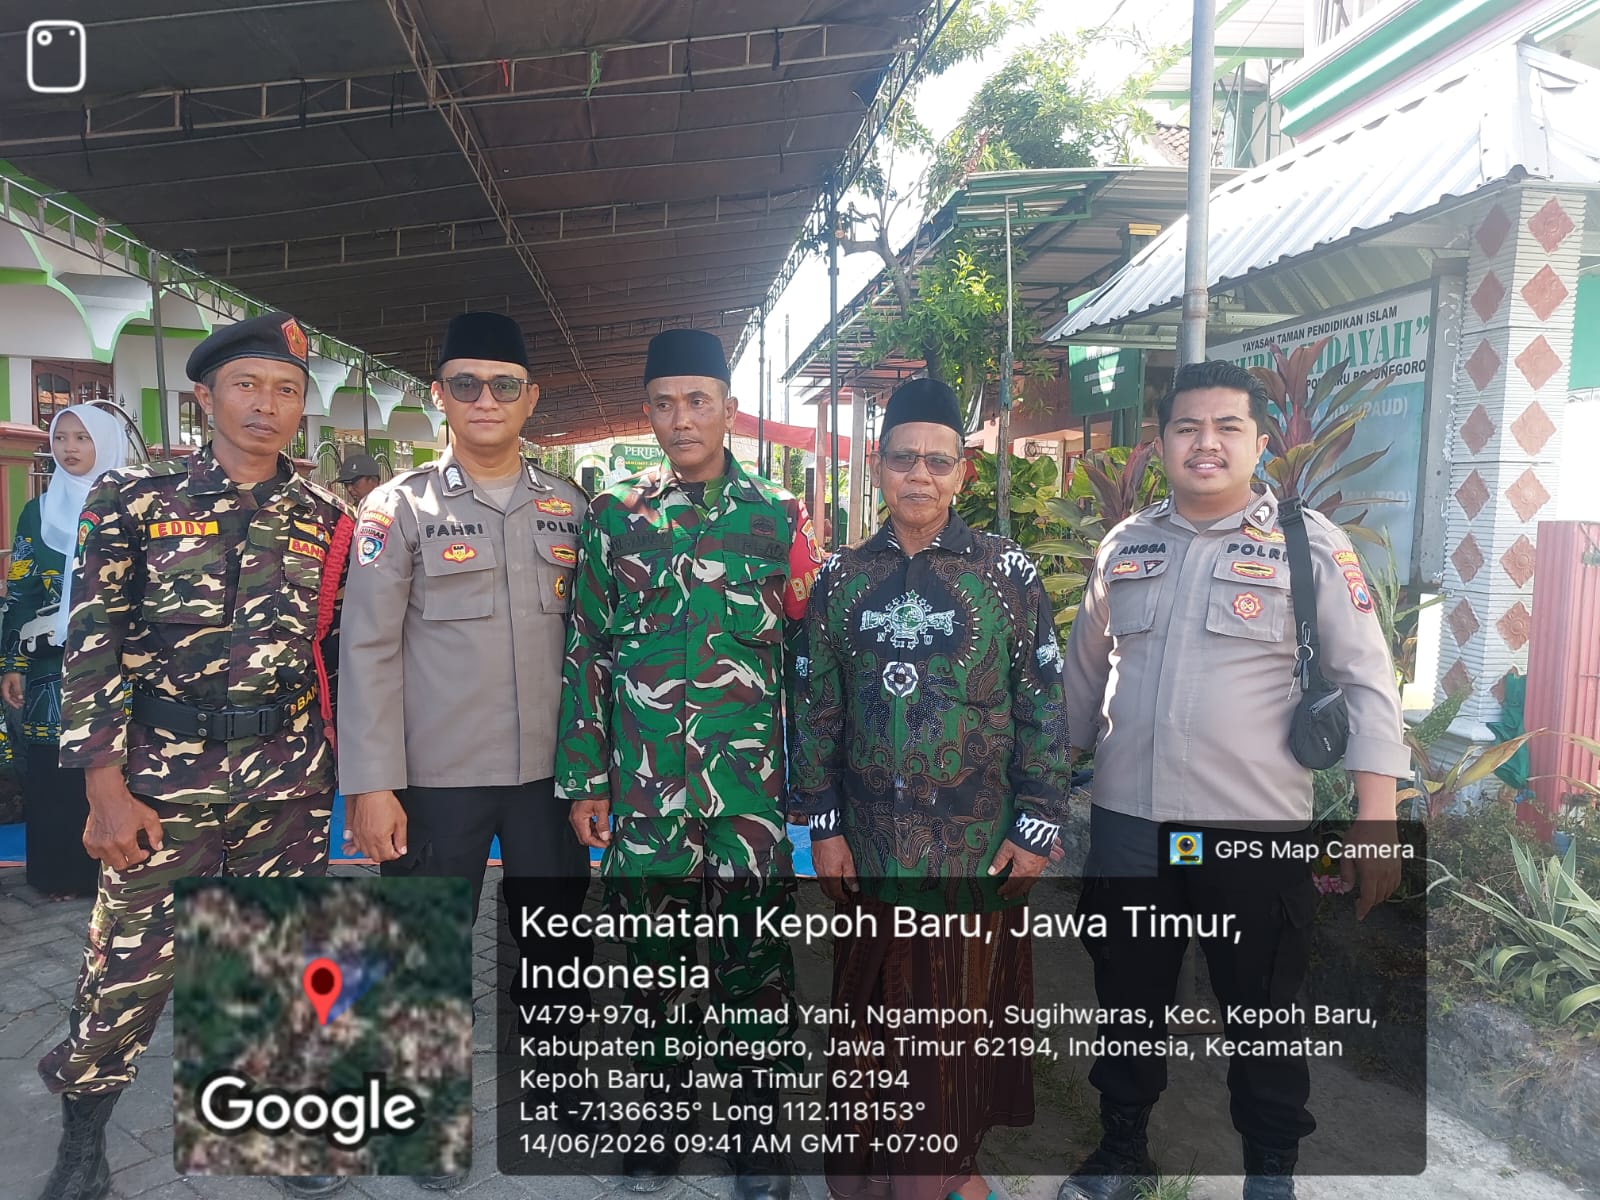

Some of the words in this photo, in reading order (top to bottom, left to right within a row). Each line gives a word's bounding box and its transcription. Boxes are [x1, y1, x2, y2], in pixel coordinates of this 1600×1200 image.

[1242, 335, 1275, 353] YAYASAN
[1277, 329, 1305, 345] TAMAN
[1307, 314, 1363, 338] PENDIDIKAN
[1366, 305, 1398, 324] ISLAM
[158, 522, 210, 537] EDDY
[426, 522, 484, 539] FAHRI
[536, 519, 581, 536] POLRI
[1118, 542, 1167, 556] ANGGA
